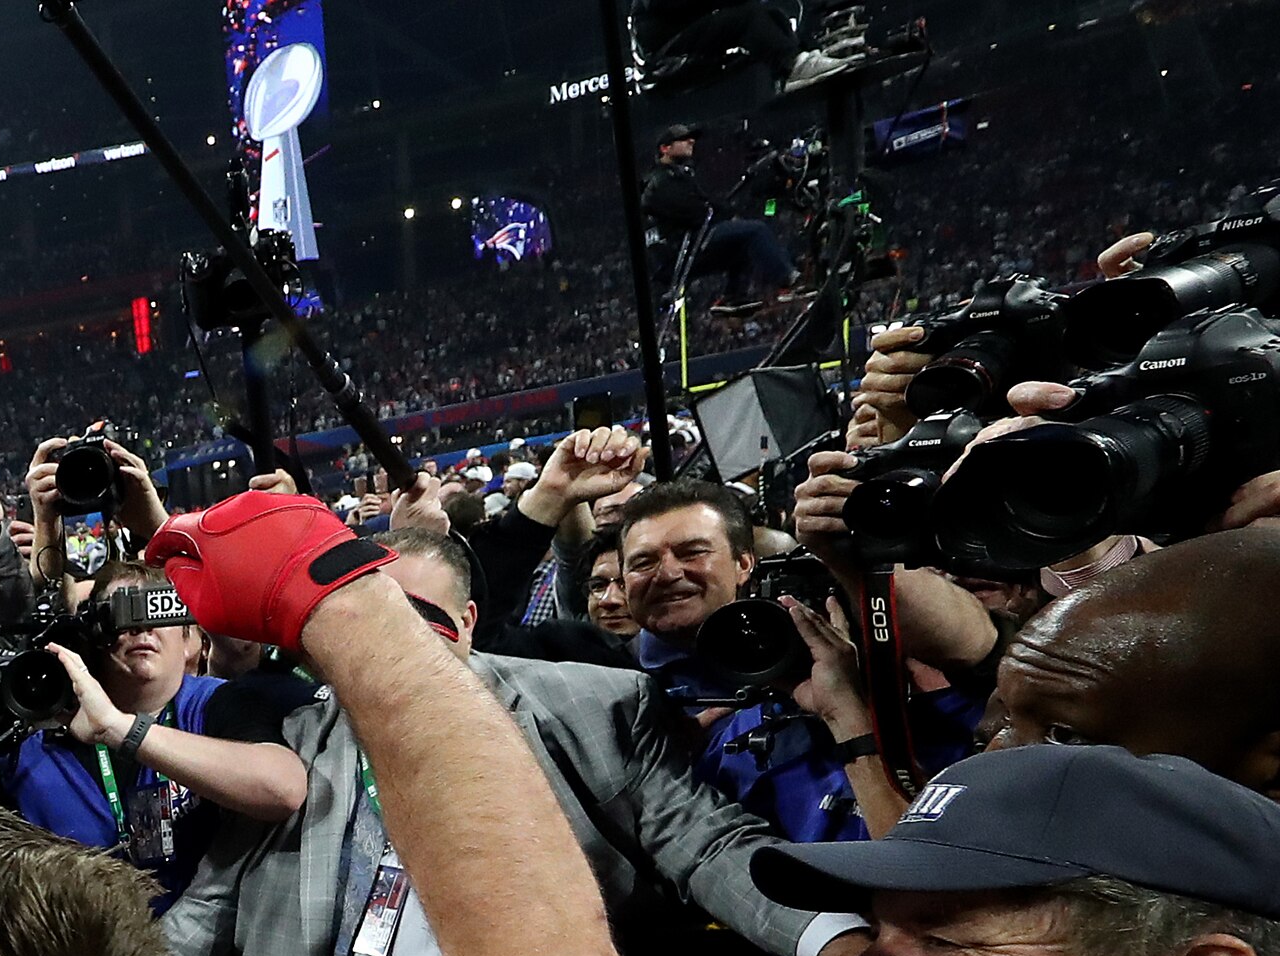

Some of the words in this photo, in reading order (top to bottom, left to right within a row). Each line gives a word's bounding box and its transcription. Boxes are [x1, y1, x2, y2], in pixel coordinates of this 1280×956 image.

[1222, 217, 1264, 231] Nikon
[970, 310, 999, 319] Canon
[1140, 358, 1186, 371] Canon
[871, 597, 889, 642] EOS
